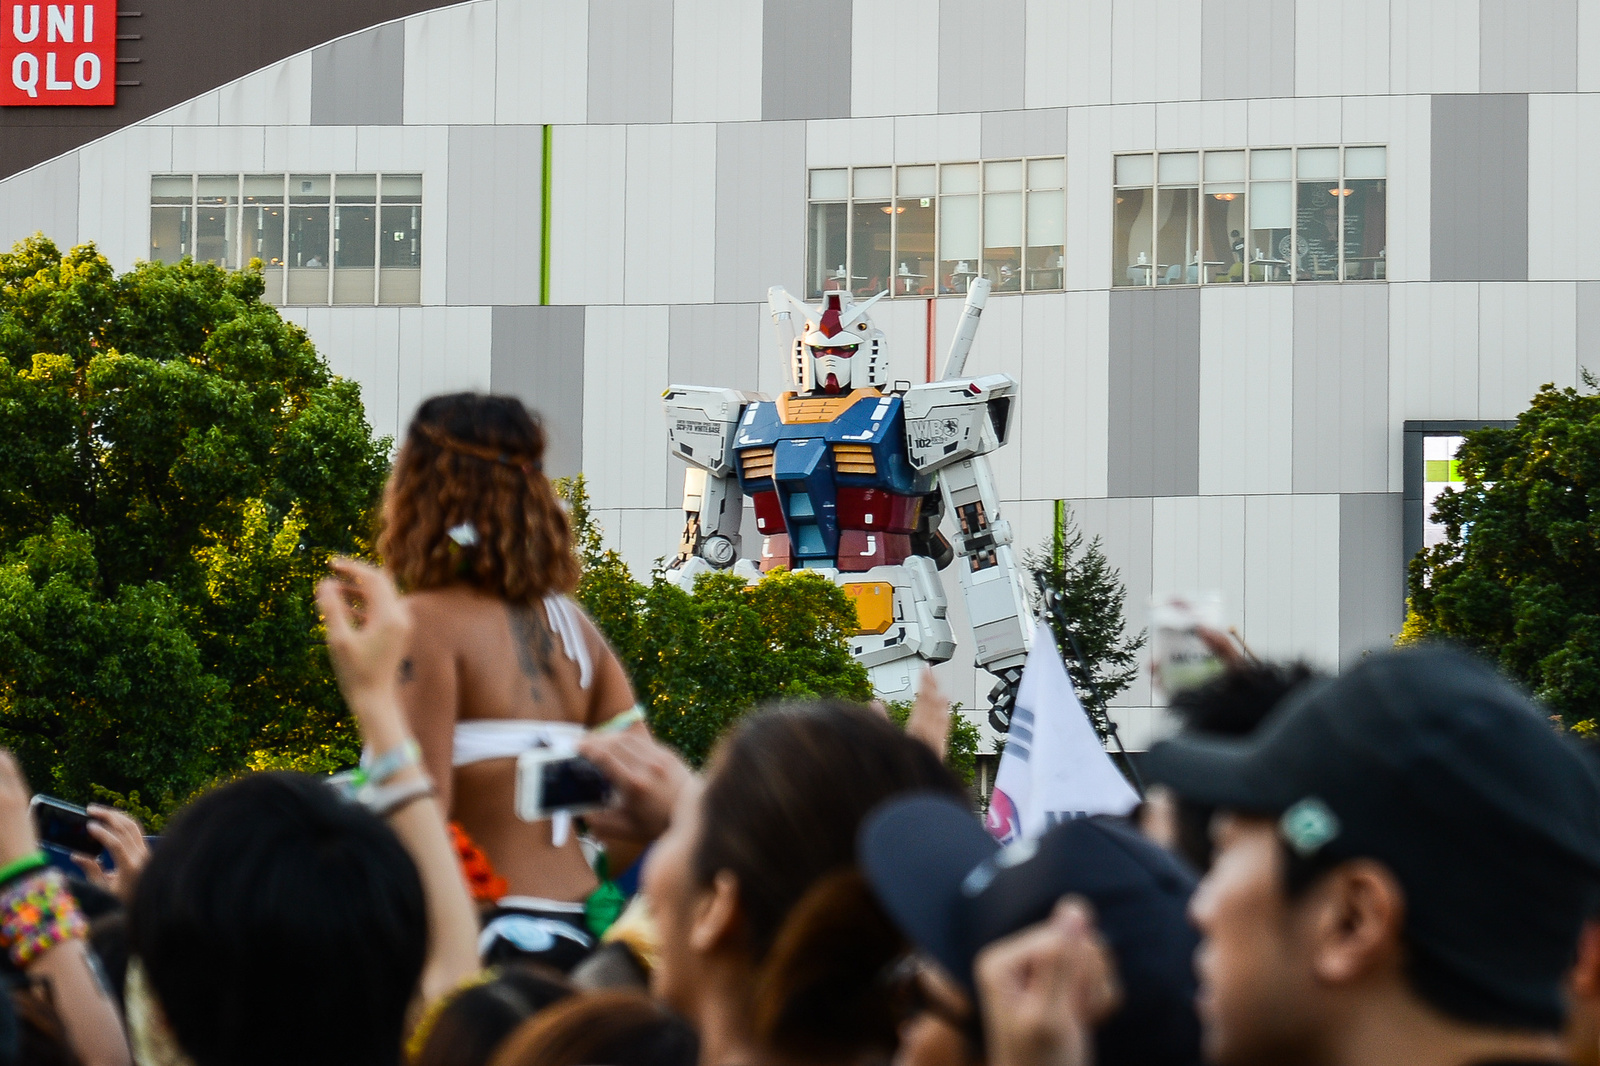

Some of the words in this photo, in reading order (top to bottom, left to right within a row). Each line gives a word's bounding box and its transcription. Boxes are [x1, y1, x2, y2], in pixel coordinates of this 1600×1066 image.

[13, 5, 94, 43] UNI
[12, 52, 101, 98] QLO
[912, 419, 944, 439] WB
[915, 438, 932, 448] 102
